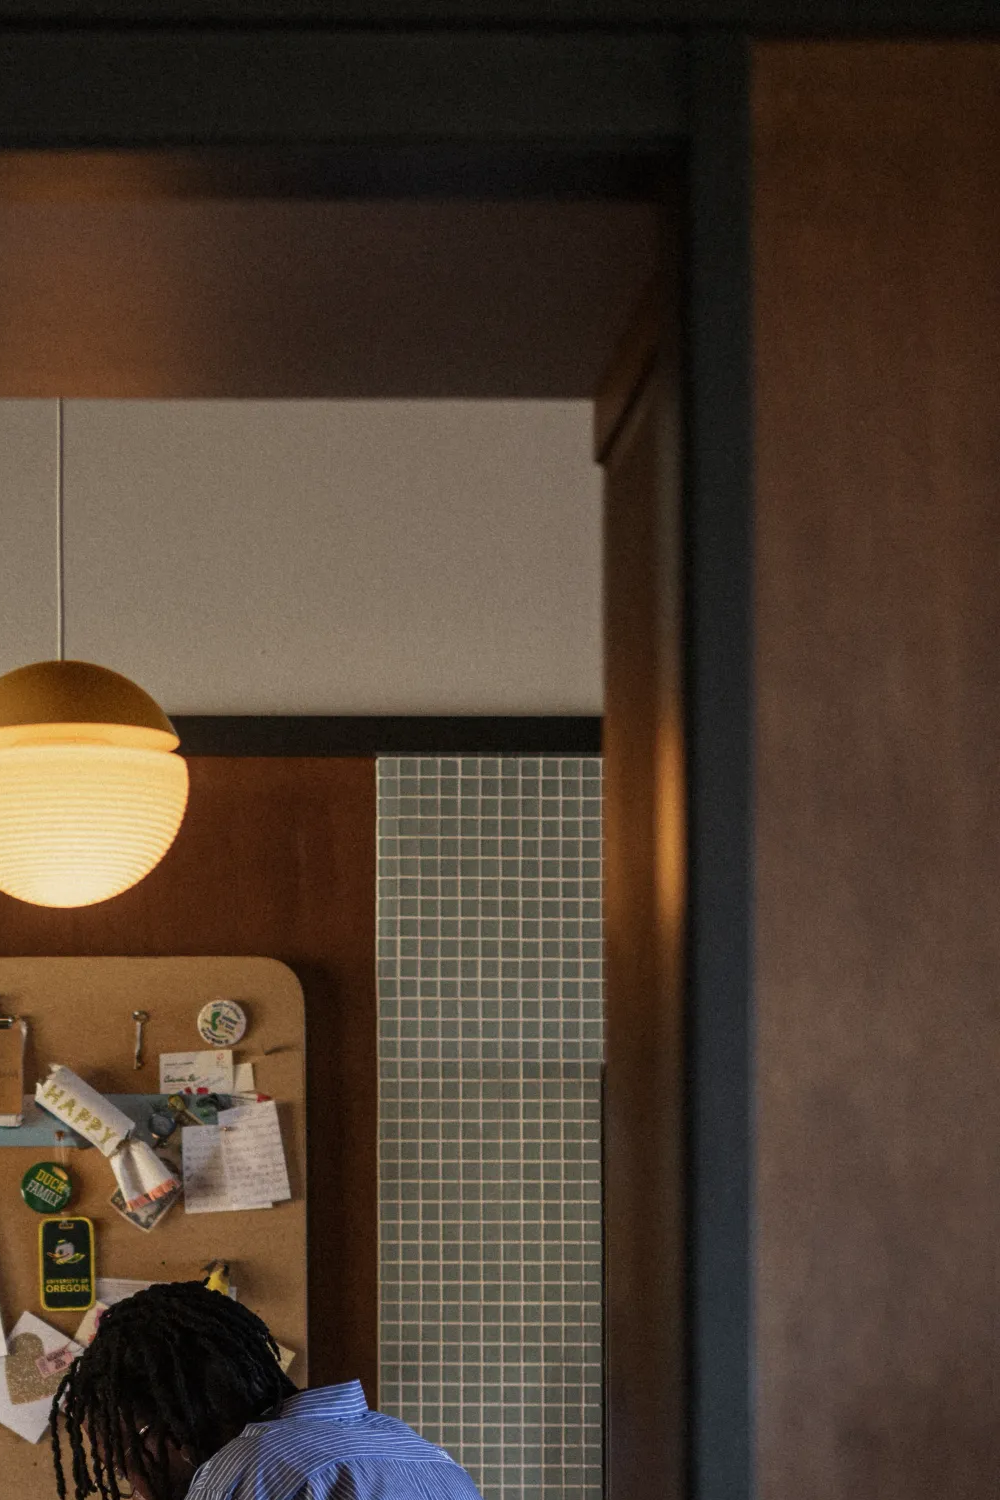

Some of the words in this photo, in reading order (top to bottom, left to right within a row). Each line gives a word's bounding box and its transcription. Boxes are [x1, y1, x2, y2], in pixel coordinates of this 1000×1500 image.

[43, 1085, 118, 1145] HAPPY
[26, 1180, 63, 1207] FAMILY
[36, 1168, 67, 1194] DUCK
[46, 1284, 89, 1293] OREGON
